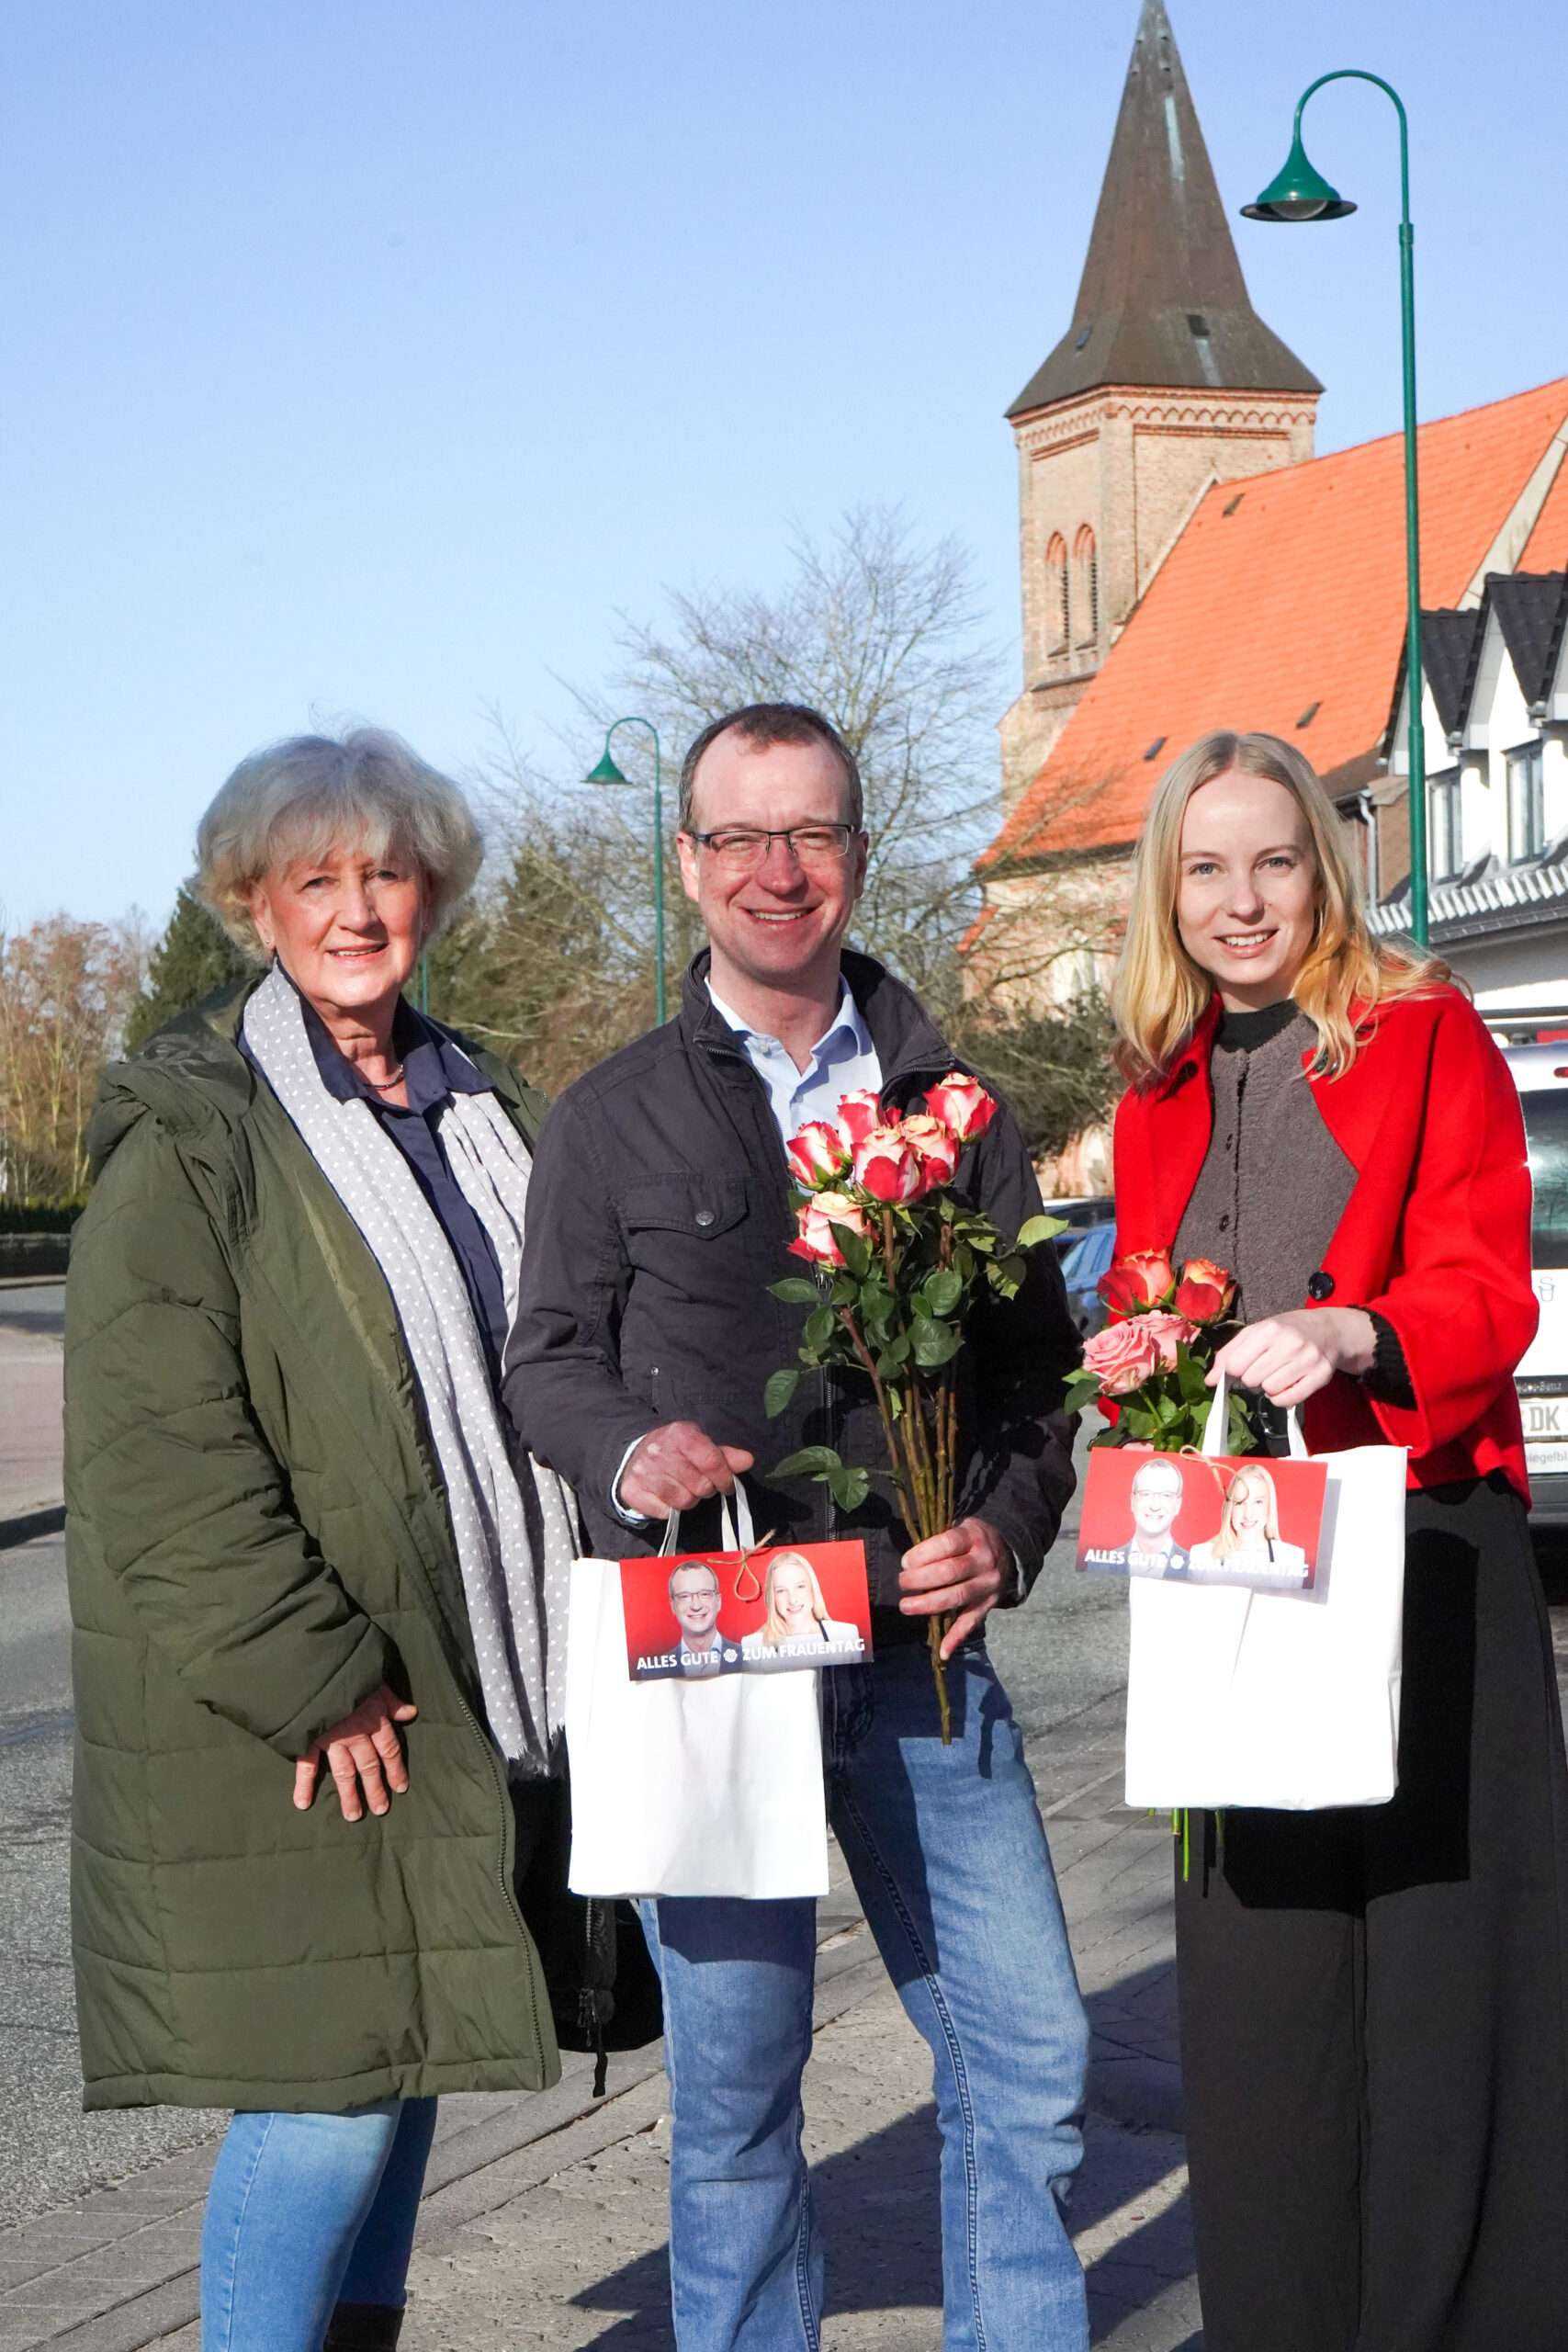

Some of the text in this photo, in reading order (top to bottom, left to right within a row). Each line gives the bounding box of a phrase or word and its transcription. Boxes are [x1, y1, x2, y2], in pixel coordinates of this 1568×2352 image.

[1084, 1549, 1125, 1565] ALLES
[637, 1638, 865, 1670] ALLES GUTE ZUM FRAUENTAG
